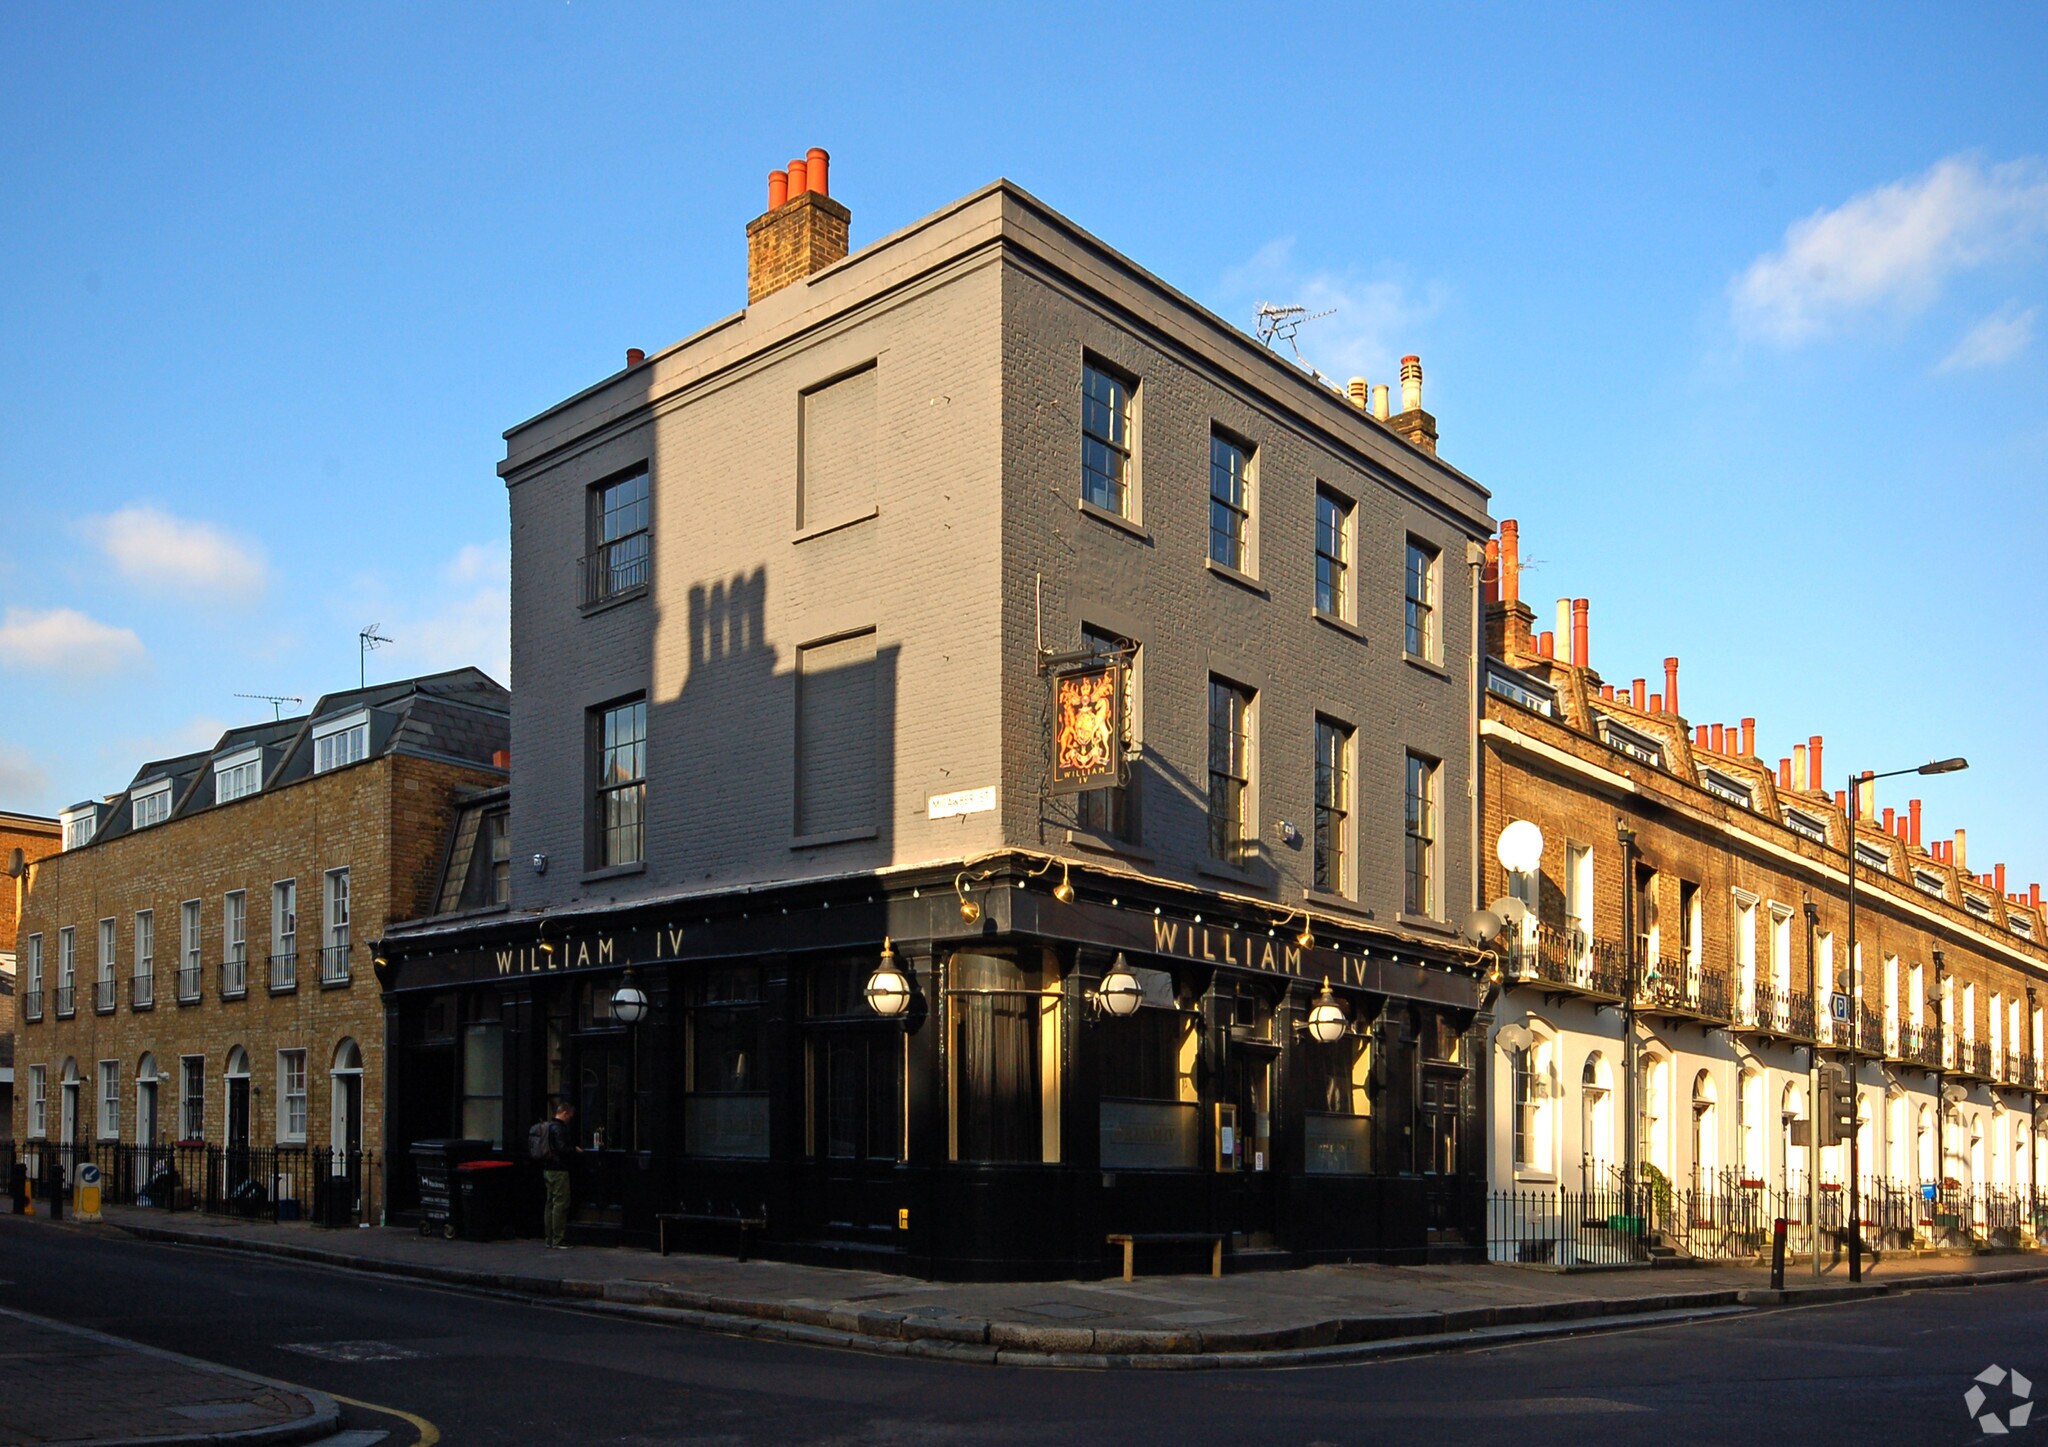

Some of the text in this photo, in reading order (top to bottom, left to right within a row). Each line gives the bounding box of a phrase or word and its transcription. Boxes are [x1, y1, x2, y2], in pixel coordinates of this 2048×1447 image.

[1063, 766, 1105, 778] WILLIAM
[1079, 776, 1088, 784] IV
[496, 929, 683, 975] WILLIAM IV
[1153, 917, 1366, 986] WILLIAM IV
[1838, 999, 1844, 1016] P
